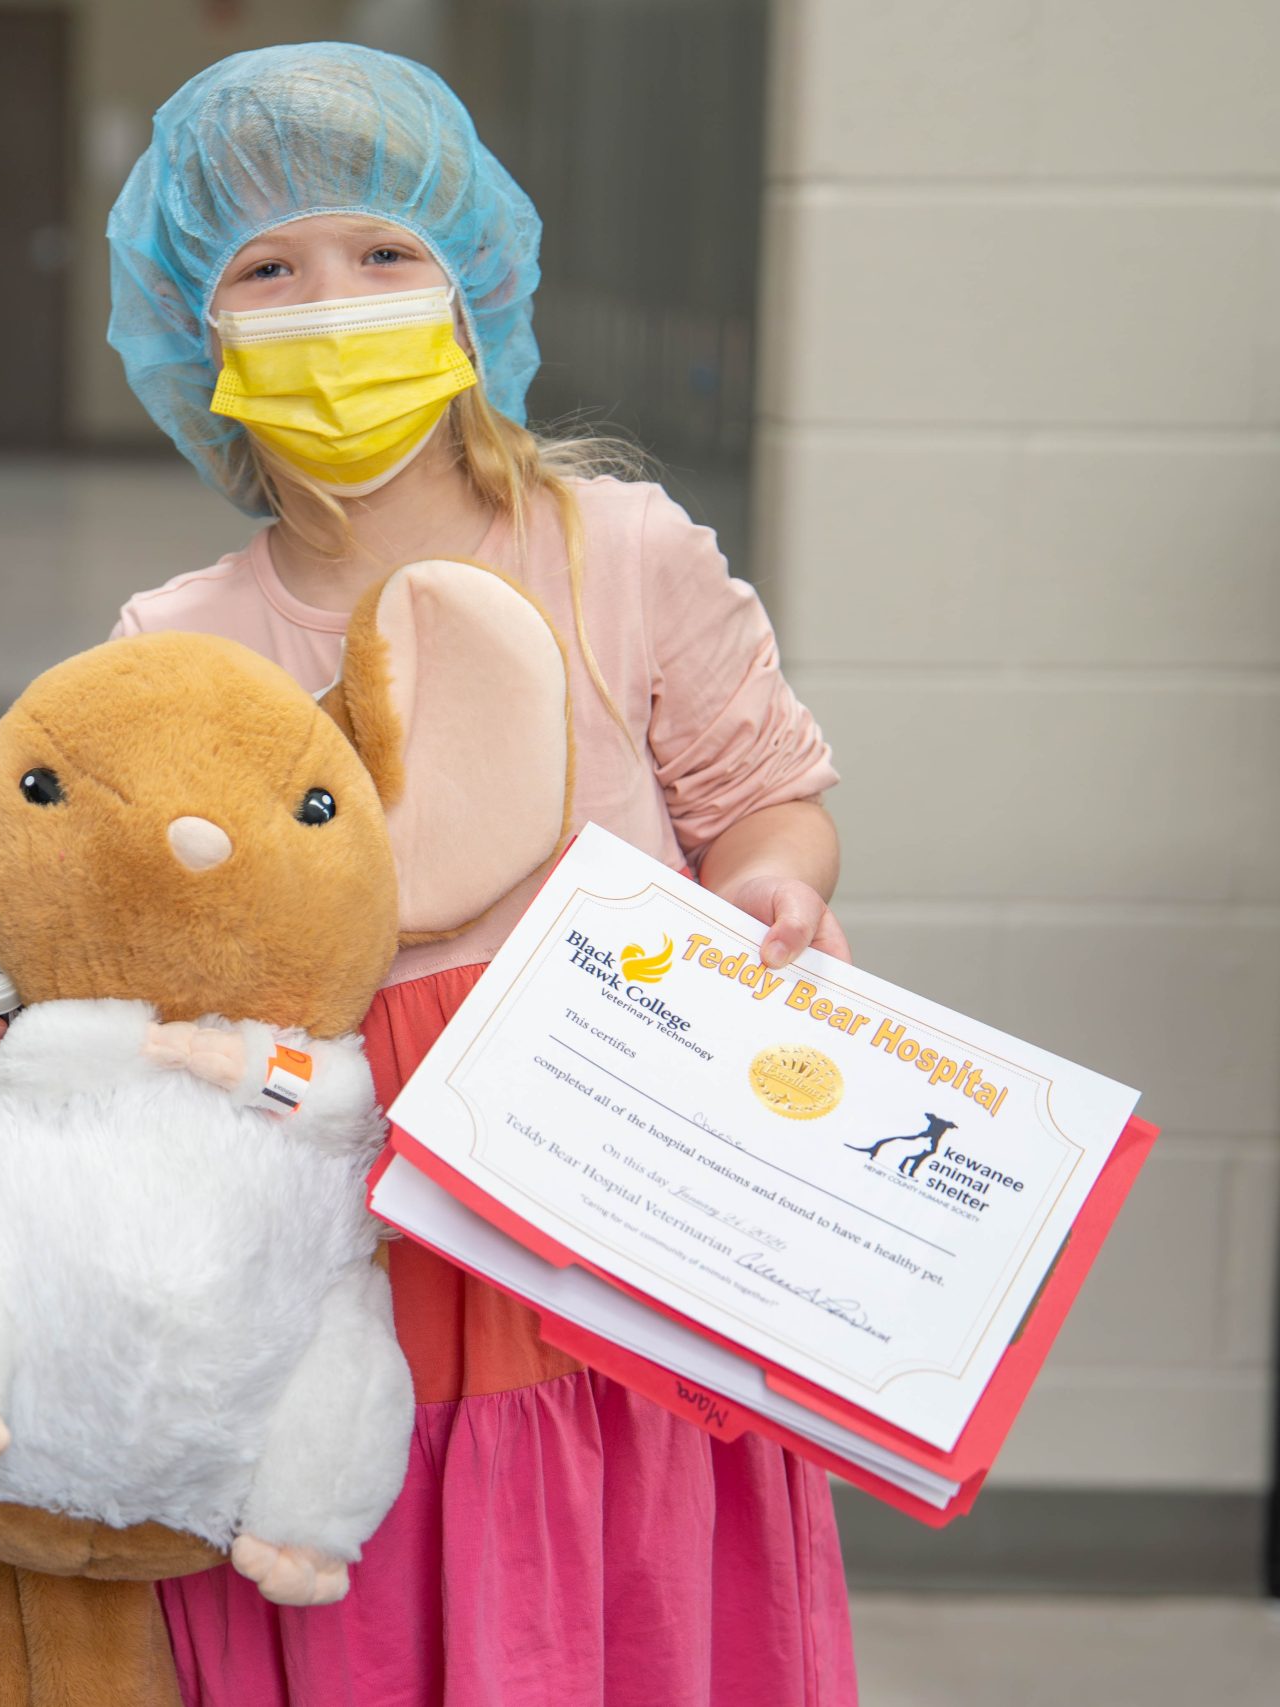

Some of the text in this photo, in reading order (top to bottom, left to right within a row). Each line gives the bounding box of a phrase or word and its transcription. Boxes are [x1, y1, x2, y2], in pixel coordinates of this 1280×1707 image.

[565, 930, 616, 969] Black
[569, 949, 691, 1032] Hawk College
[565, 1008, 636, 1059] This certifies
[601, 987, 715, 1062] Veterinary Technology
[682, 933, 1009, 1118] Teddy Bear Hospital
[504, 1112, 733, 1257] Teddy Bear Hospital Veterinarian
[532, 1055, 945, 1287] completed all of the hospital rotations and found to have a healthy pet.
[602, 1143, 621, 1160] On
[623, 1155, 647, 1175] this
[647, 1170, 670, 1189] day
[863, 1163, 980, 1223] HENRY COUNTY HUMANE SOCIETY
[928, 1159, 990, 1195] animal
[943, 1146, 1025, 1193] kewanee
[926, 1176, 990, 1212] shelter
